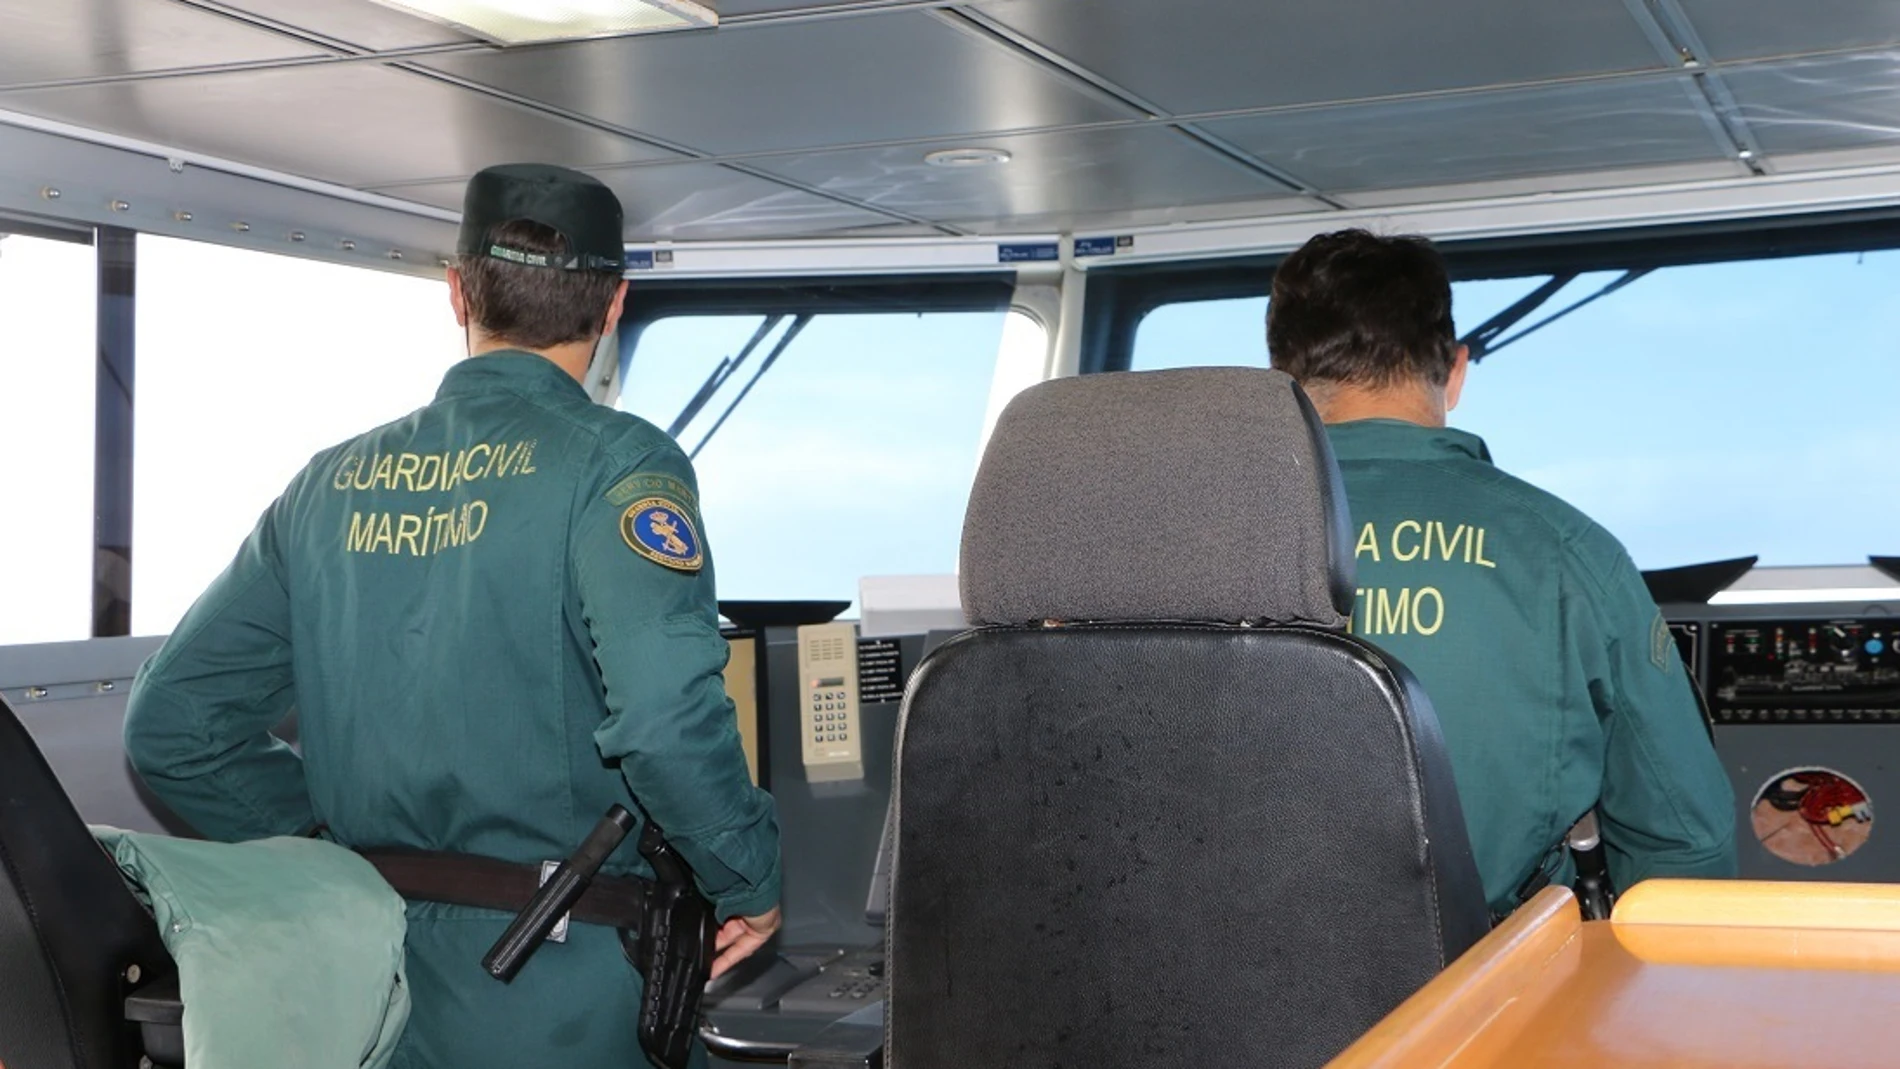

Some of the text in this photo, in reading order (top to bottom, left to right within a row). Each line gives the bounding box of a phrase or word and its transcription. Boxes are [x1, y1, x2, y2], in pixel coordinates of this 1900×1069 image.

[334, 439, 537, 491] GUARDIA CIVIL
[1391, 520, 1497, 568] CIVIL
